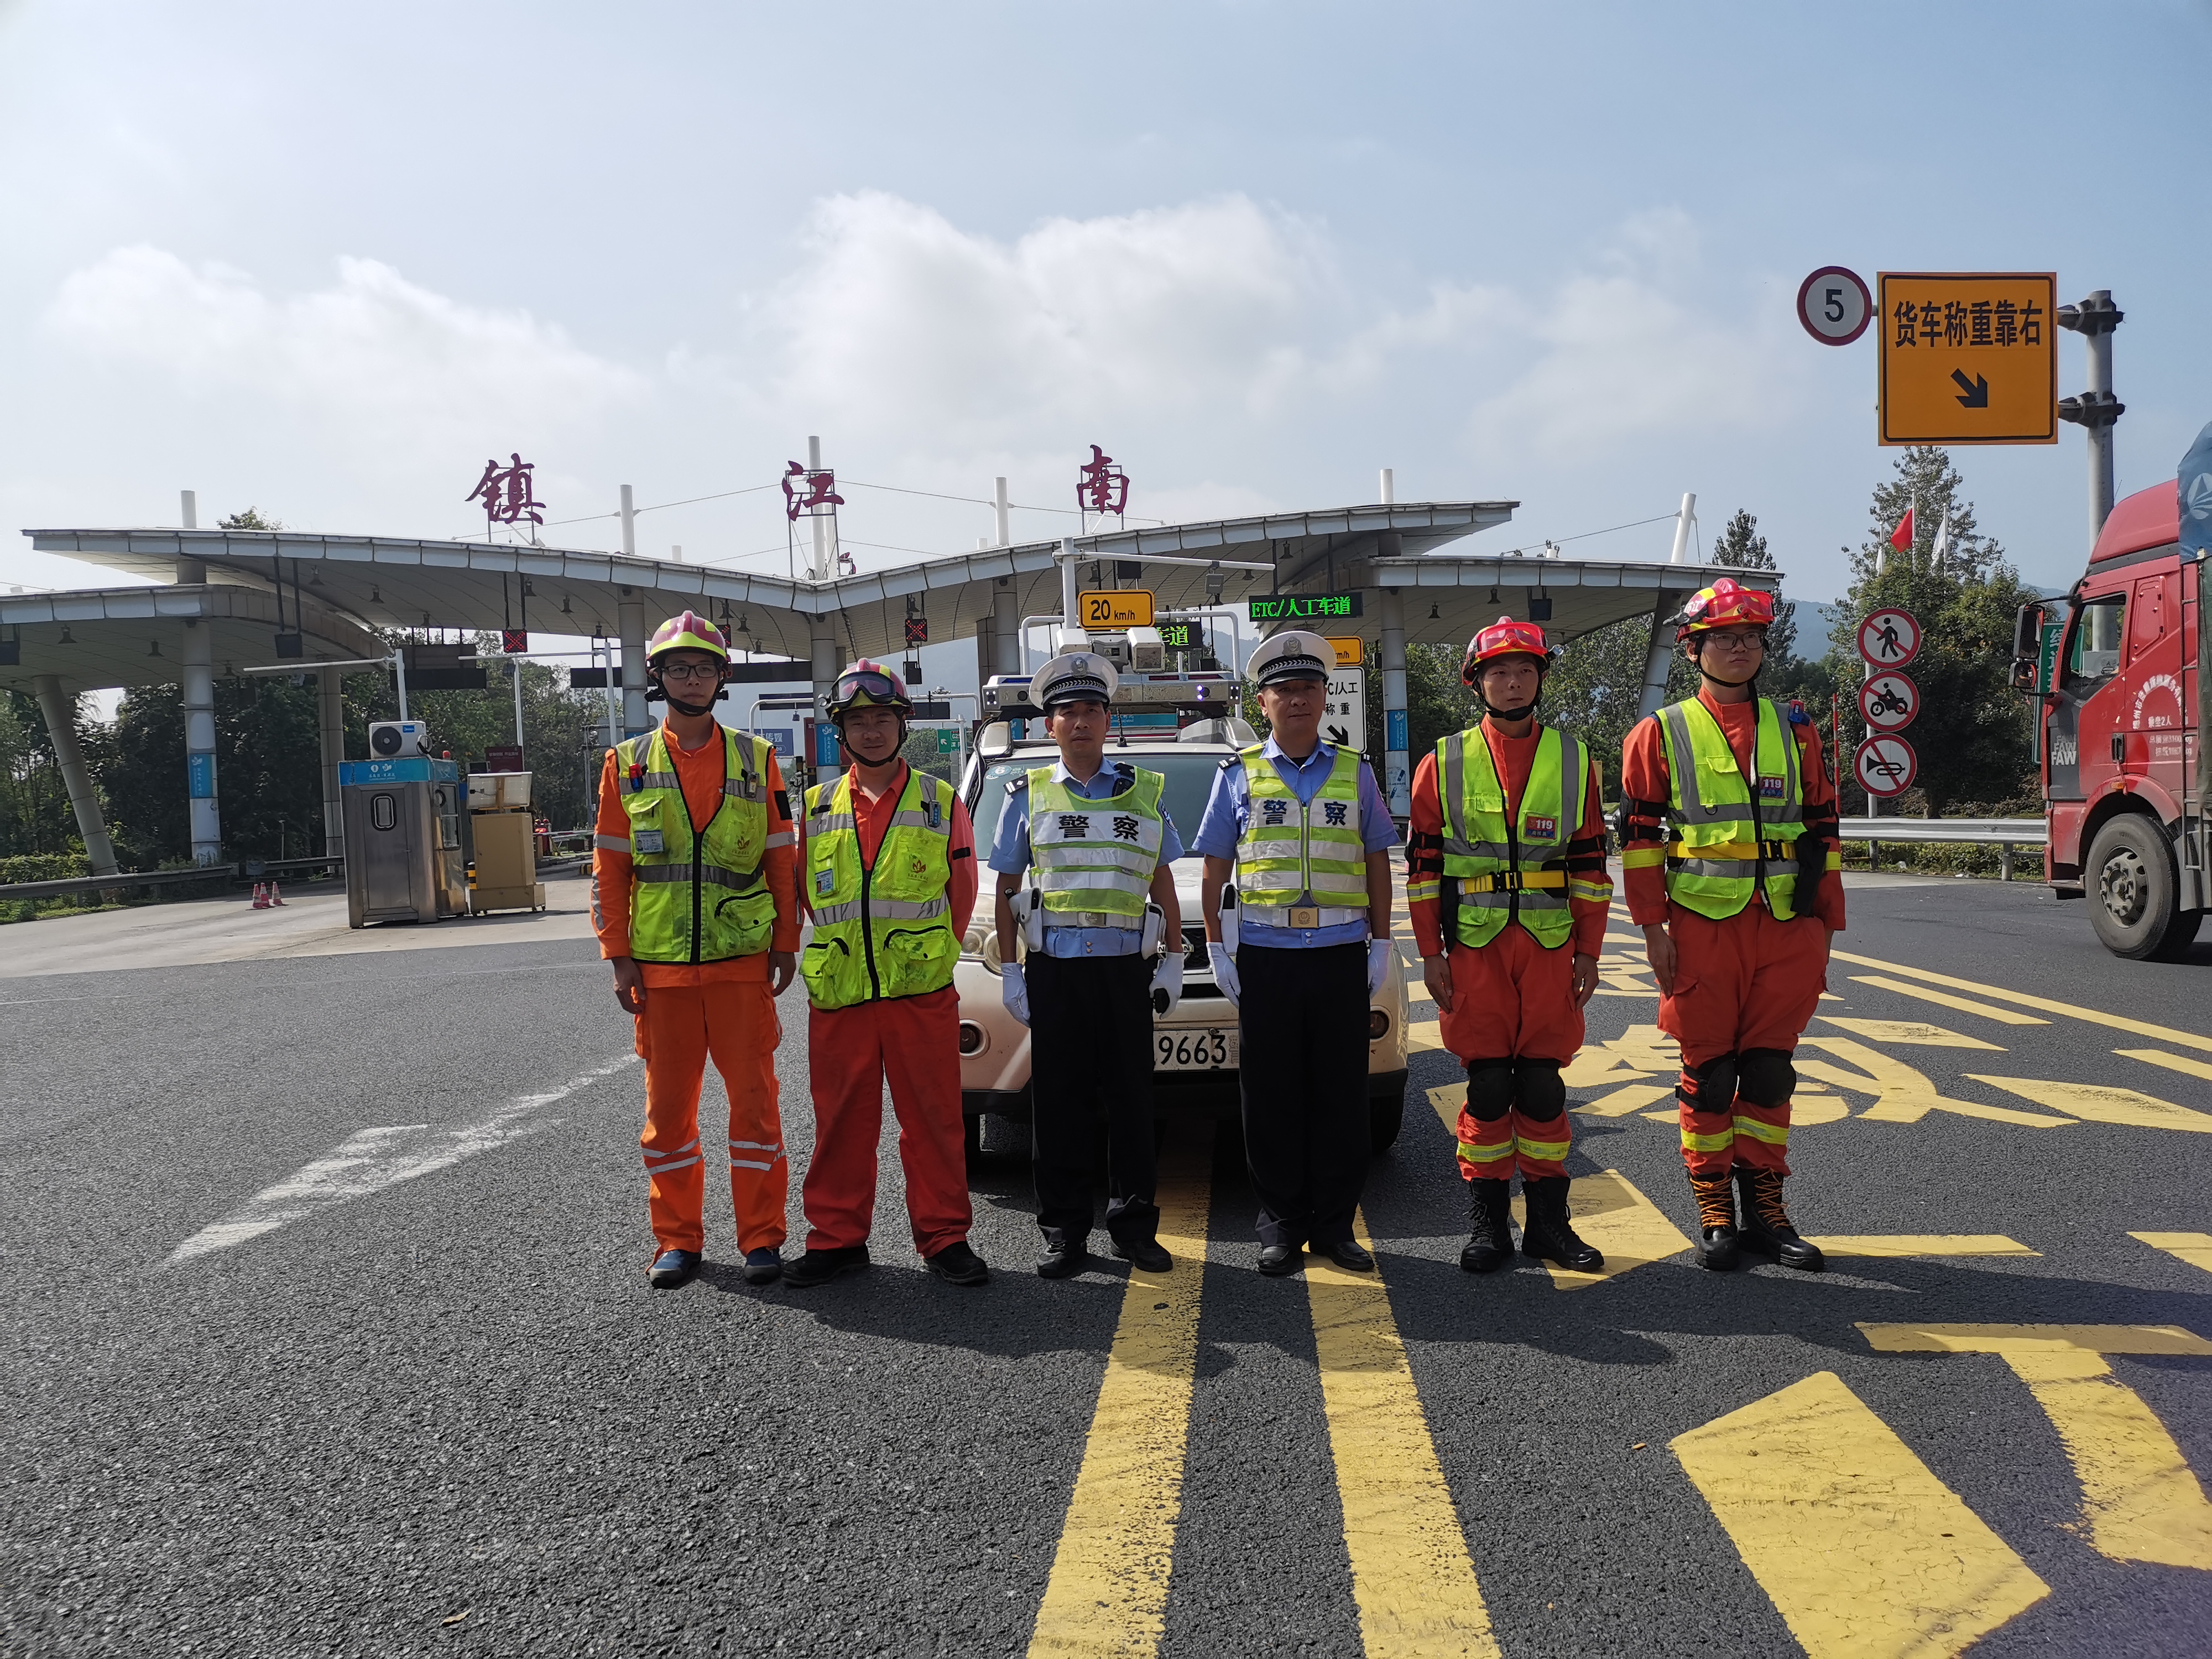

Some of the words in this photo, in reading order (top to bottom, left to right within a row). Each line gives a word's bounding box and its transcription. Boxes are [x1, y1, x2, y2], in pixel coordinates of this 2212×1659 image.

[1824, 288, 1844, 322] 5
[1893, 299, 2043, 348] 货车称重靠右
[1090, 599, 1111, 620] 20
[1114, 609, 1135, 620] km/h
[1251, 596, 1351, 618] ETC/人工车道
[1325, 702, 1350, 716] 称重
[2051, 751, 2077, 765] FAW
[1762, 779, 1782, 789] 119
[1262, 800, 1348, 826] 警察
[1058, 815, 1139, 842] 警察
[1535, 819, 1553, 830] 119
